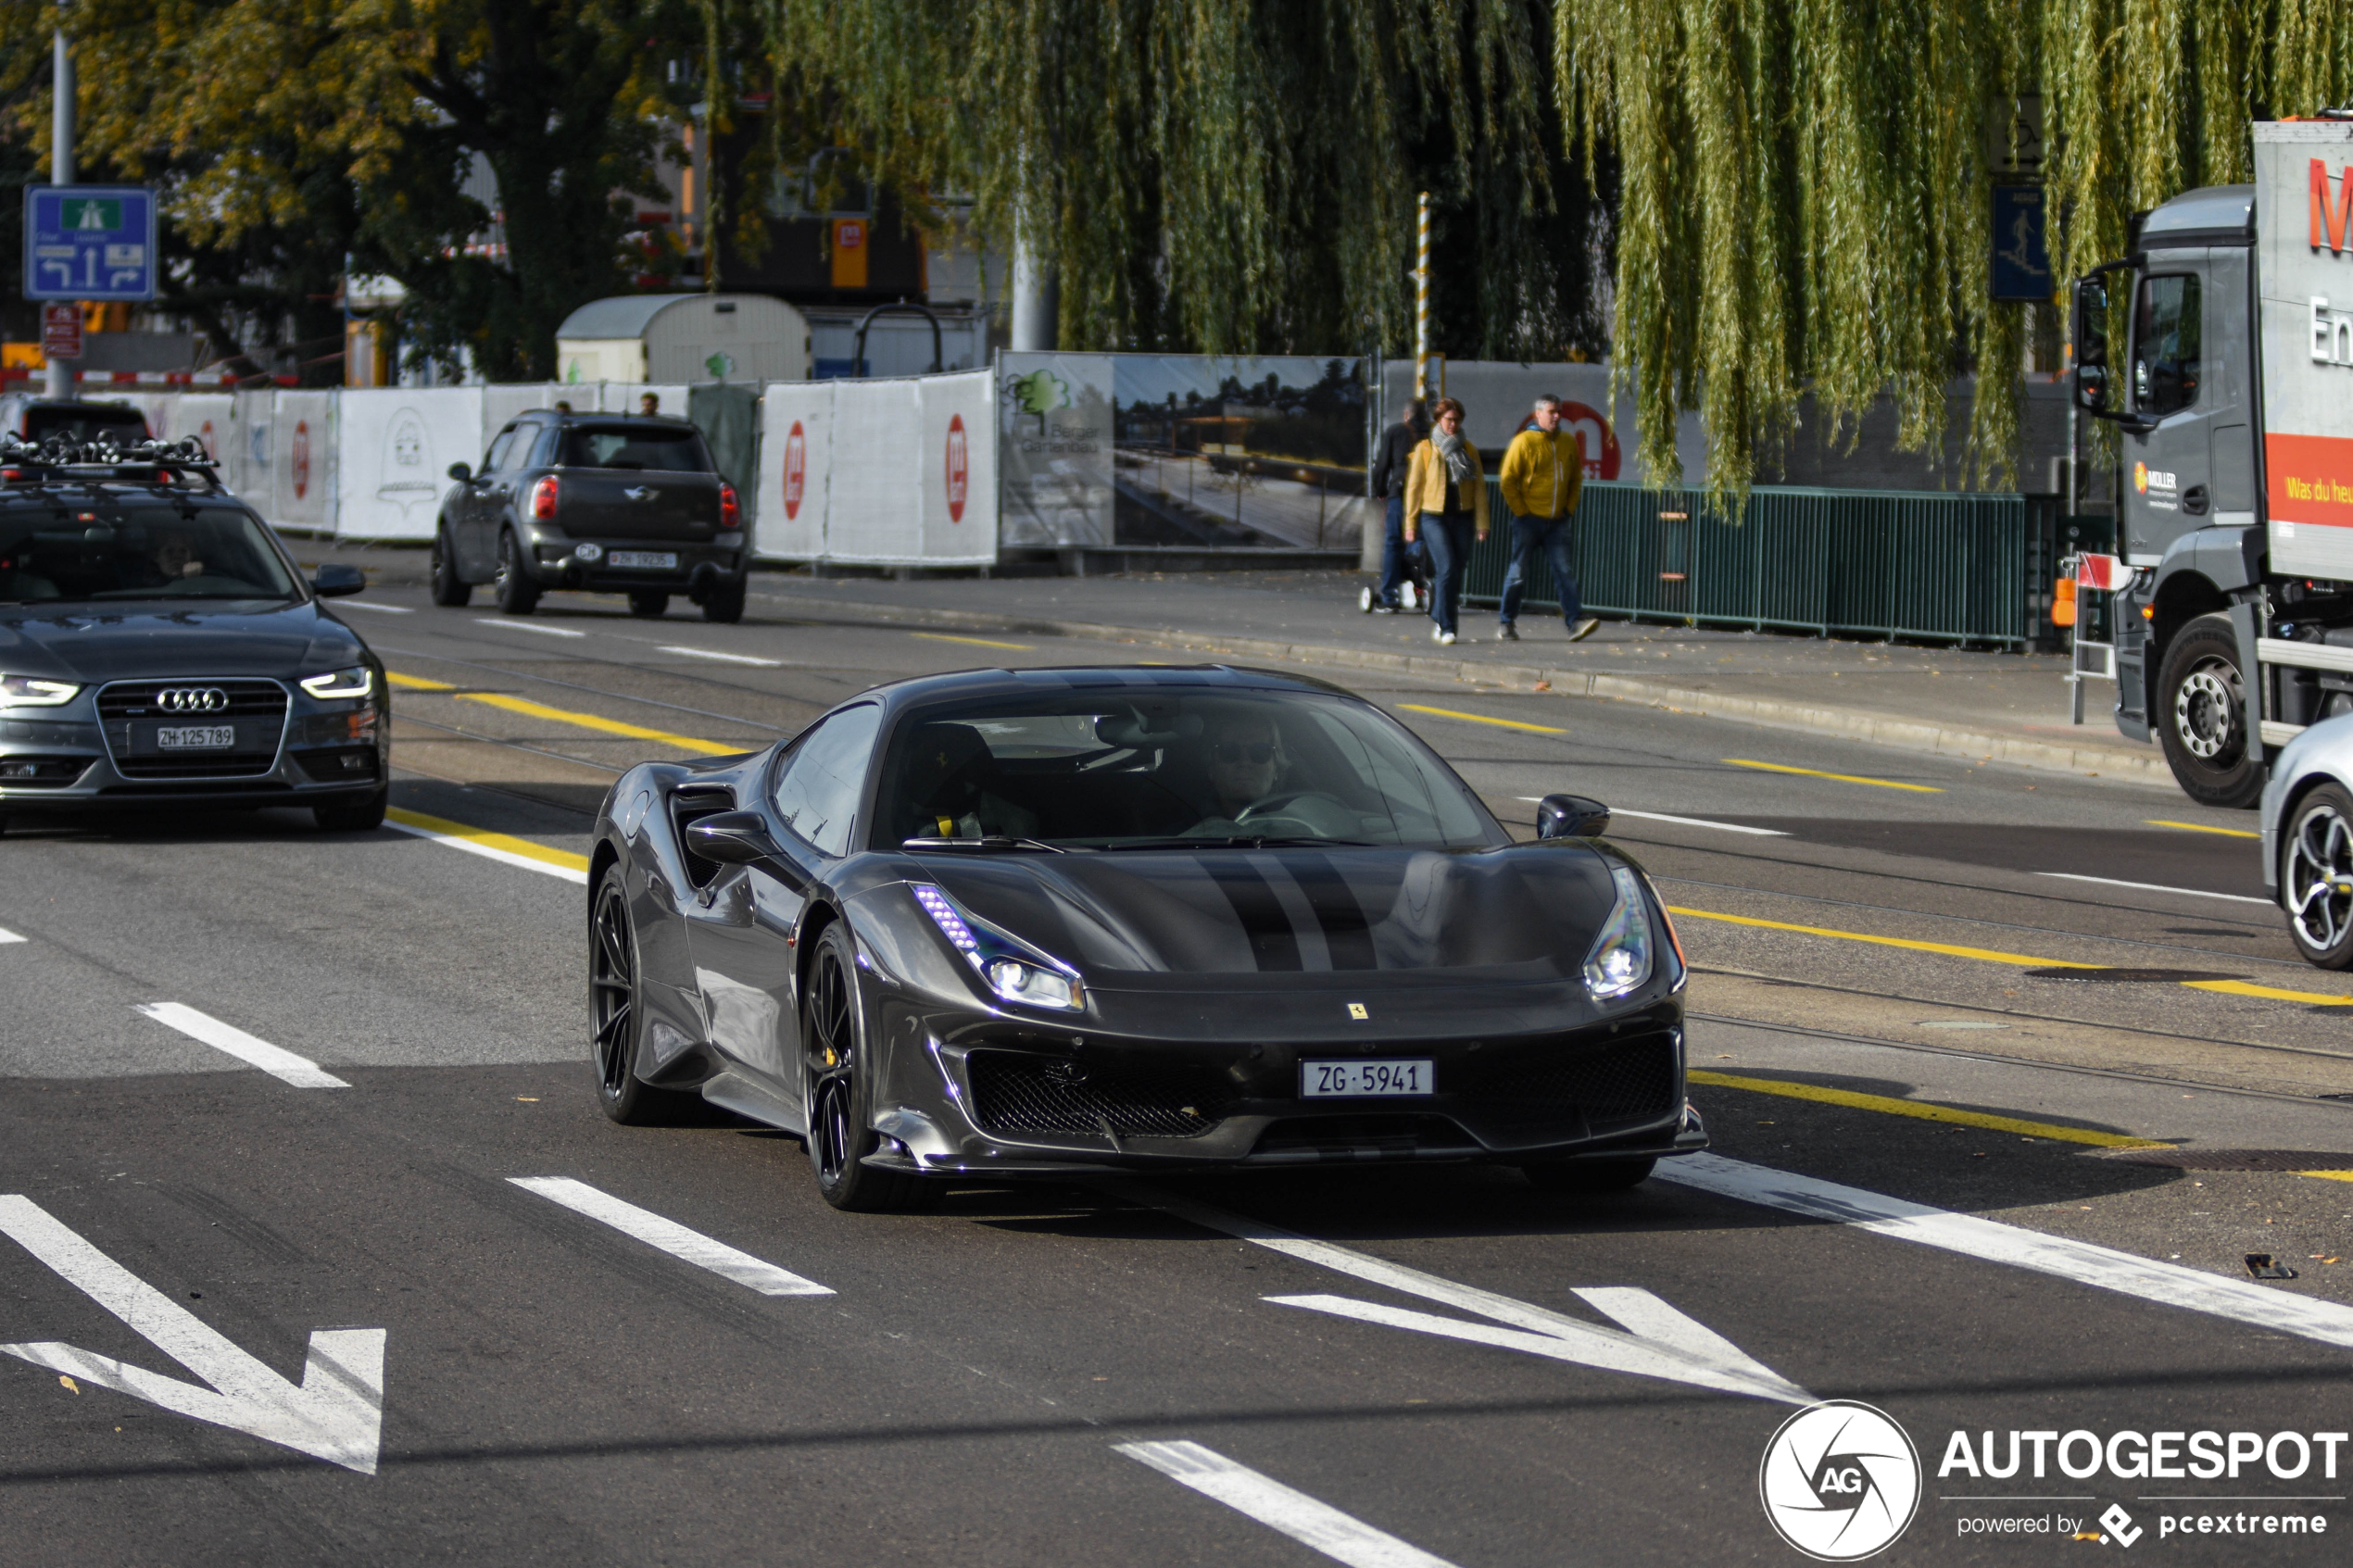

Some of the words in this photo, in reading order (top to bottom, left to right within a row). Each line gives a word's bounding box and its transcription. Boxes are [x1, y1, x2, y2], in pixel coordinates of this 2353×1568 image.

[1051, 424, 1100, 441] Berger
[1022, 439, 1098, 453] Gartenbau
[2285, 476, 2312, 500] Was
[2315, 477, 2330, 501] du
[580, 546, 597, 558] CH
